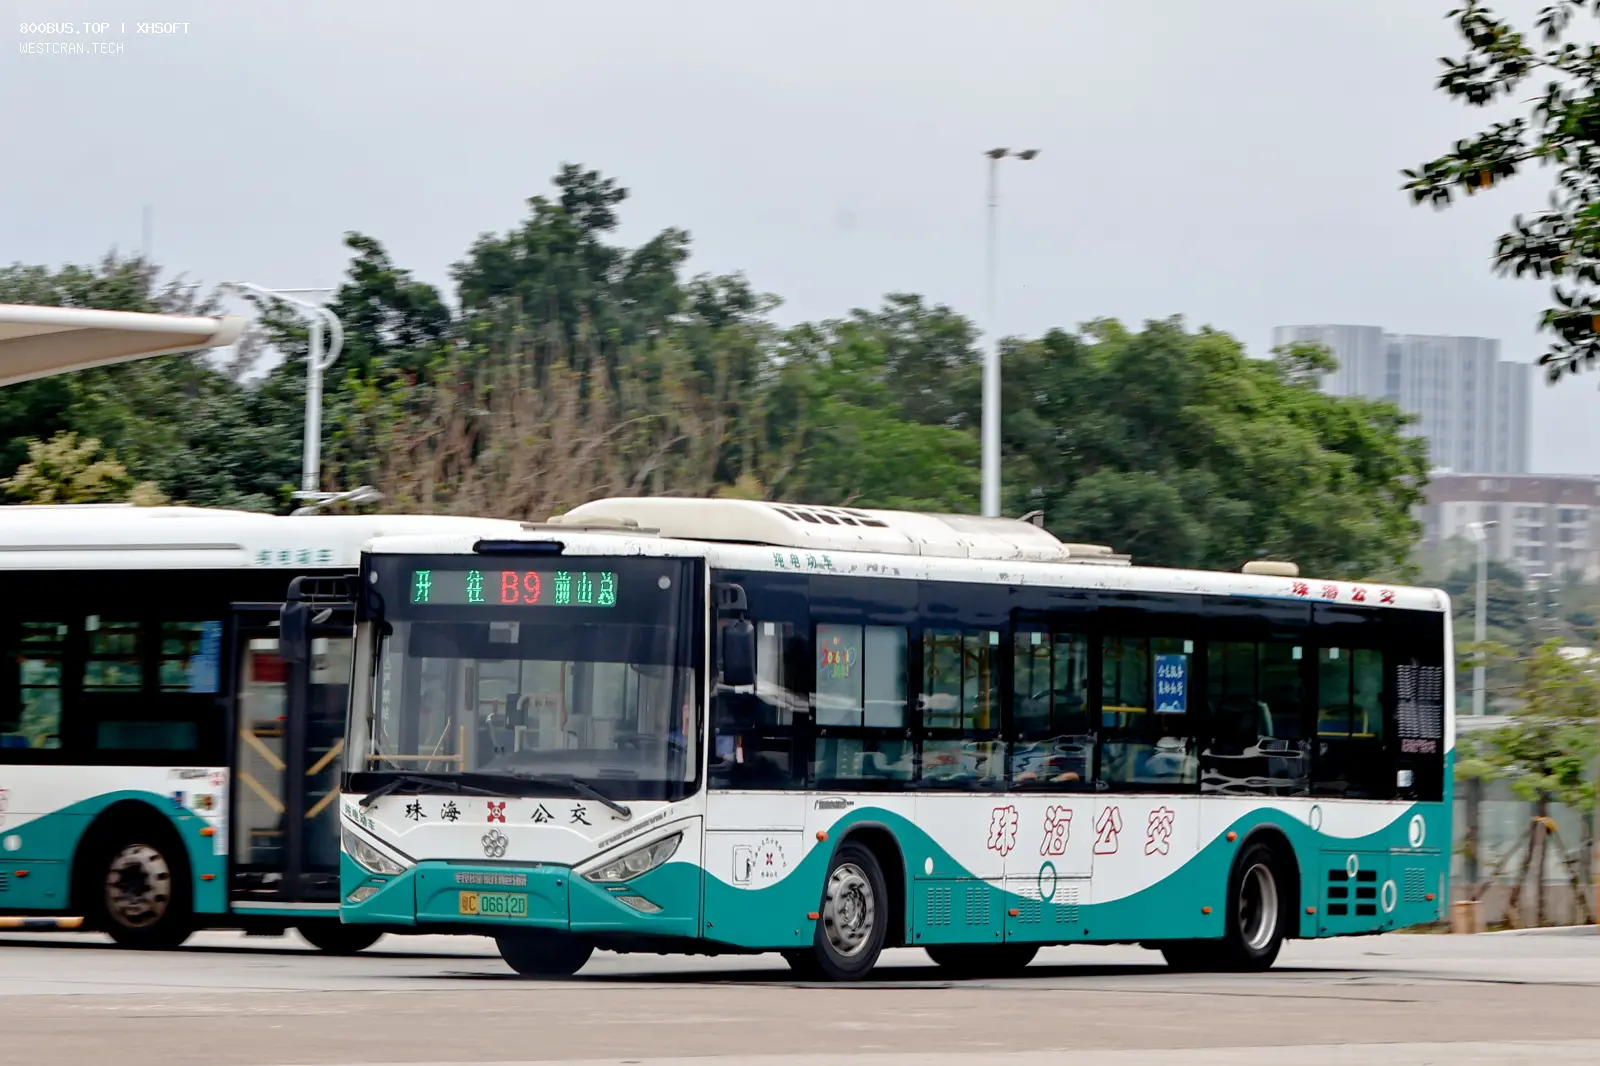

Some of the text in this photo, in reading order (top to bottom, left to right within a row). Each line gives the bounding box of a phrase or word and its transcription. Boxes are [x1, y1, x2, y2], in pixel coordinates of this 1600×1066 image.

[500, 571, 541, 604] B9
[553, 572, 616, 605] 前山总
[987, 805, 1176, 857] 珠海公交
